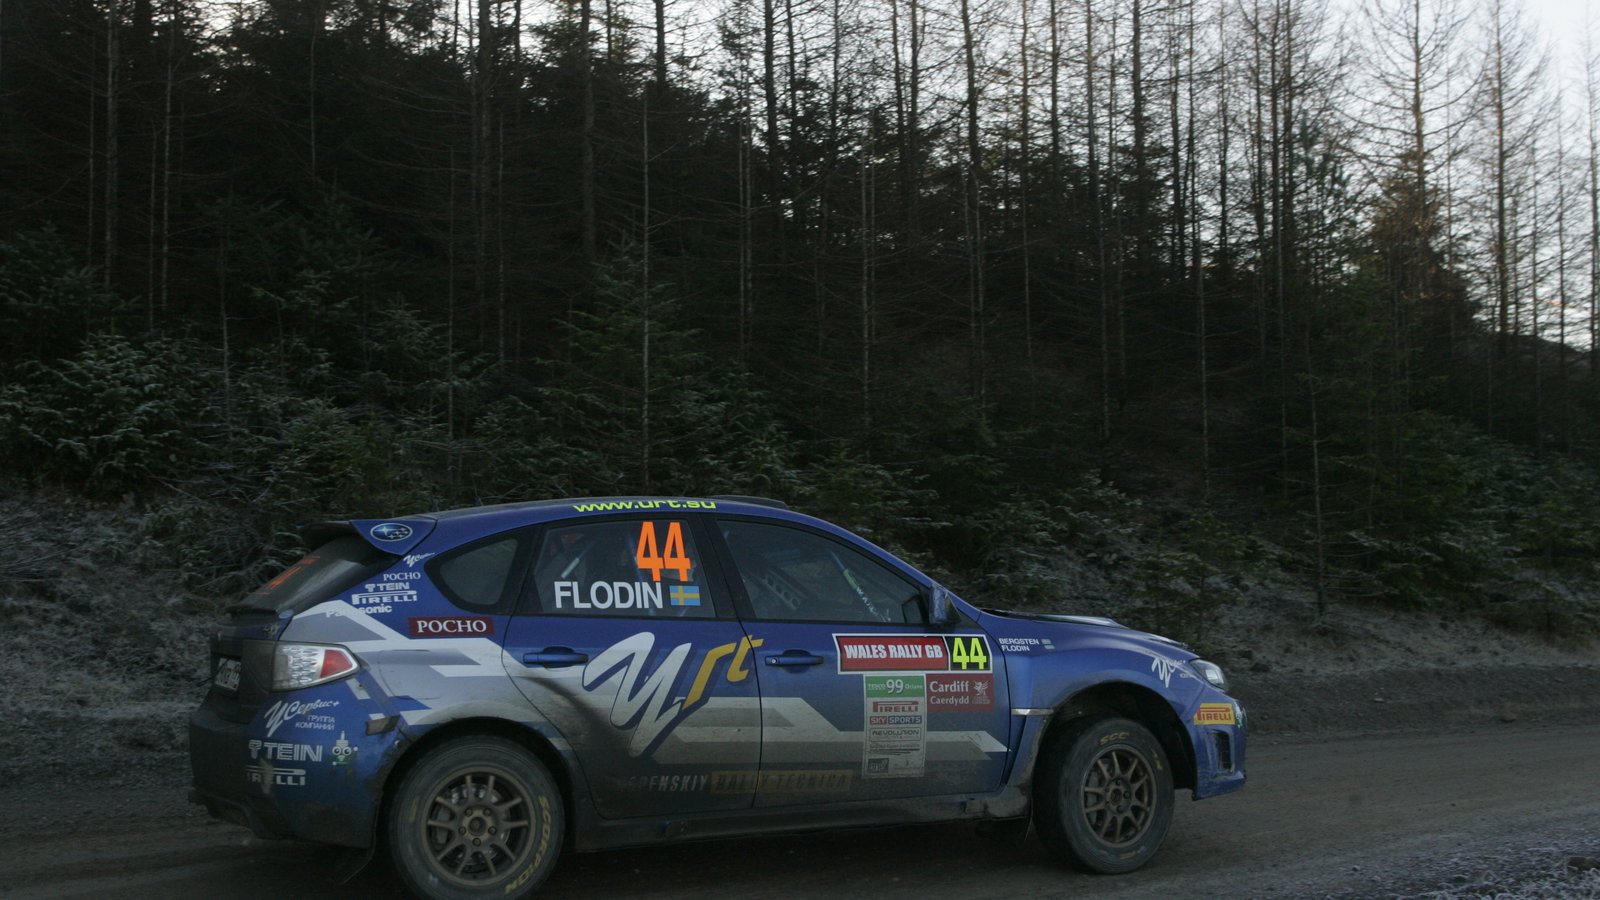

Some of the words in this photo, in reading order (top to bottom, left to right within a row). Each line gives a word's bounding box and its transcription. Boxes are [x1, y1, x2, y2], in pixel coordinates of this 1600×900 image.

[573, 499, 717, 512] www.urt.su
[636, 521, 692, 582] 44
[377, 582, 410, 592] TEIN
[351, 590, 418, 605] PIRELLI
[554, 581, 664, 609] FLODIN
[844, 644, 887, 659] WALES
[889, 644, 923, 659] RALLY
[925, 644, 944, 659] GB
[952, 637, 988, 670] 44
[886, 679, 904, 694] 99
[930, 681, 969, 693] Cardiff
[873, 701, 919, 712] PIRELLI
[931, 696, 970, 706] Caerdydd
[307, 714, 336, 723] ГРУППА
[871, 717, 887, 725] SKY
[889, 716, 921, 725] SPORTS
[1197, 707, 1232, 721] PIRELLI
[263, 742, 323, 762] TEIN
